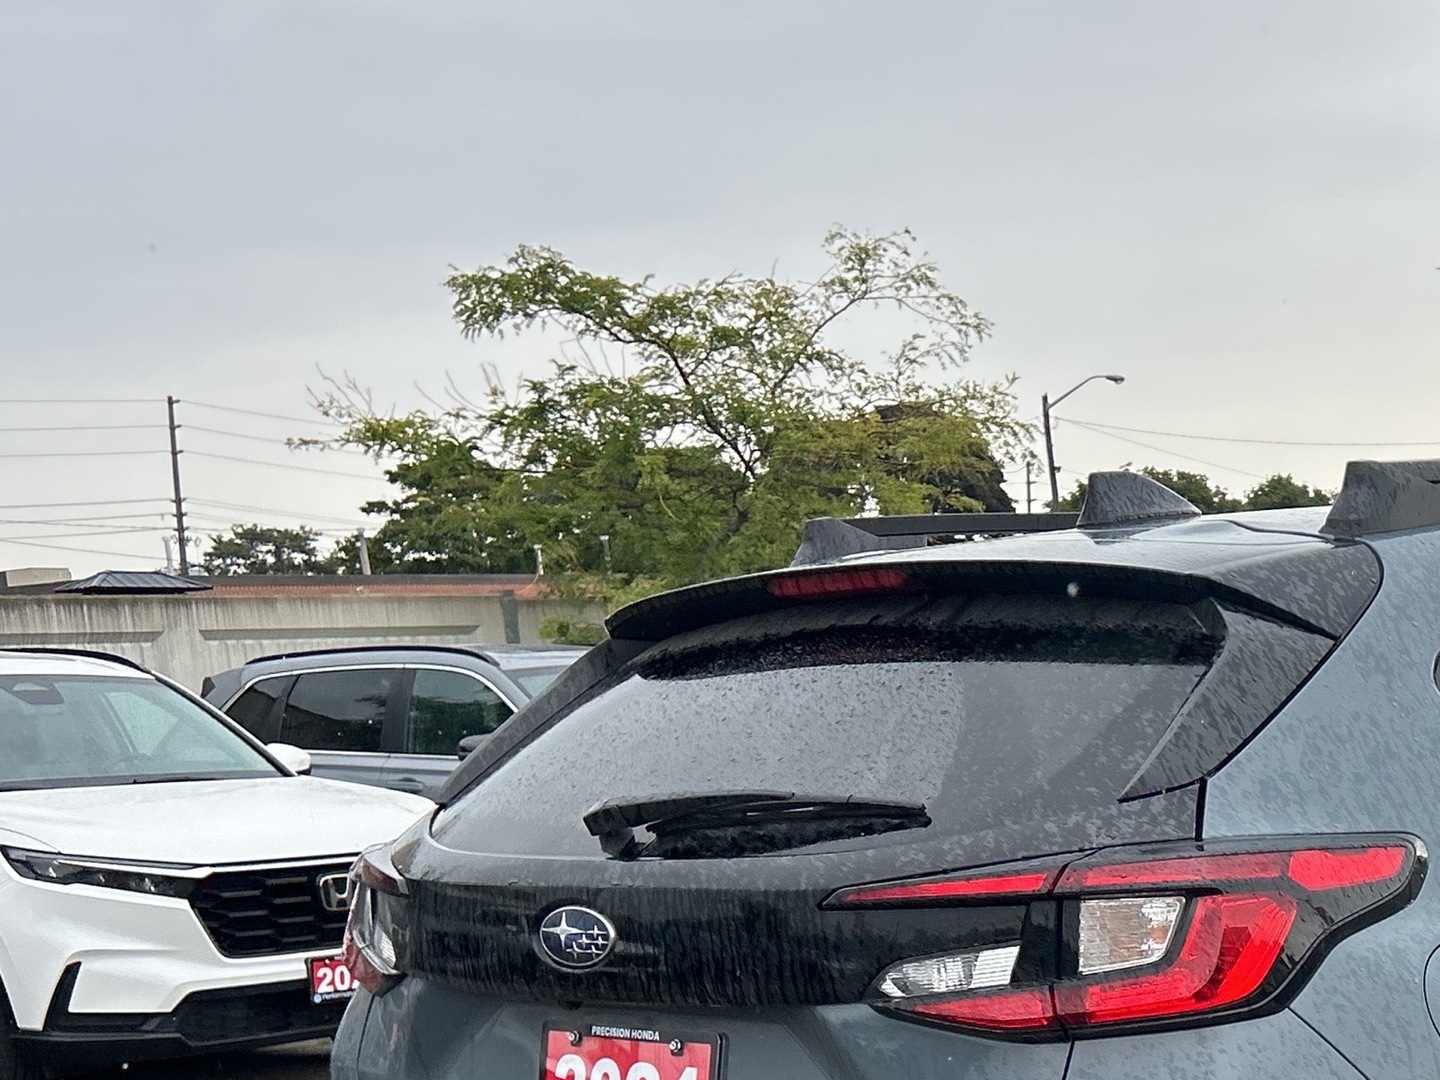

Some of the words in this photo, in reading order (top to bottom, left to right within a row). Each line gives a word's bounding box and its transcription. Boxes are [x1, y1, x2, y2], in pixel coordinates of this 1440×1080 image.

[316, 965, 360, 994] 20
[591, 1025, 631, 1039] PRECISION
[631, 1029, 660, 1041] HONDA
